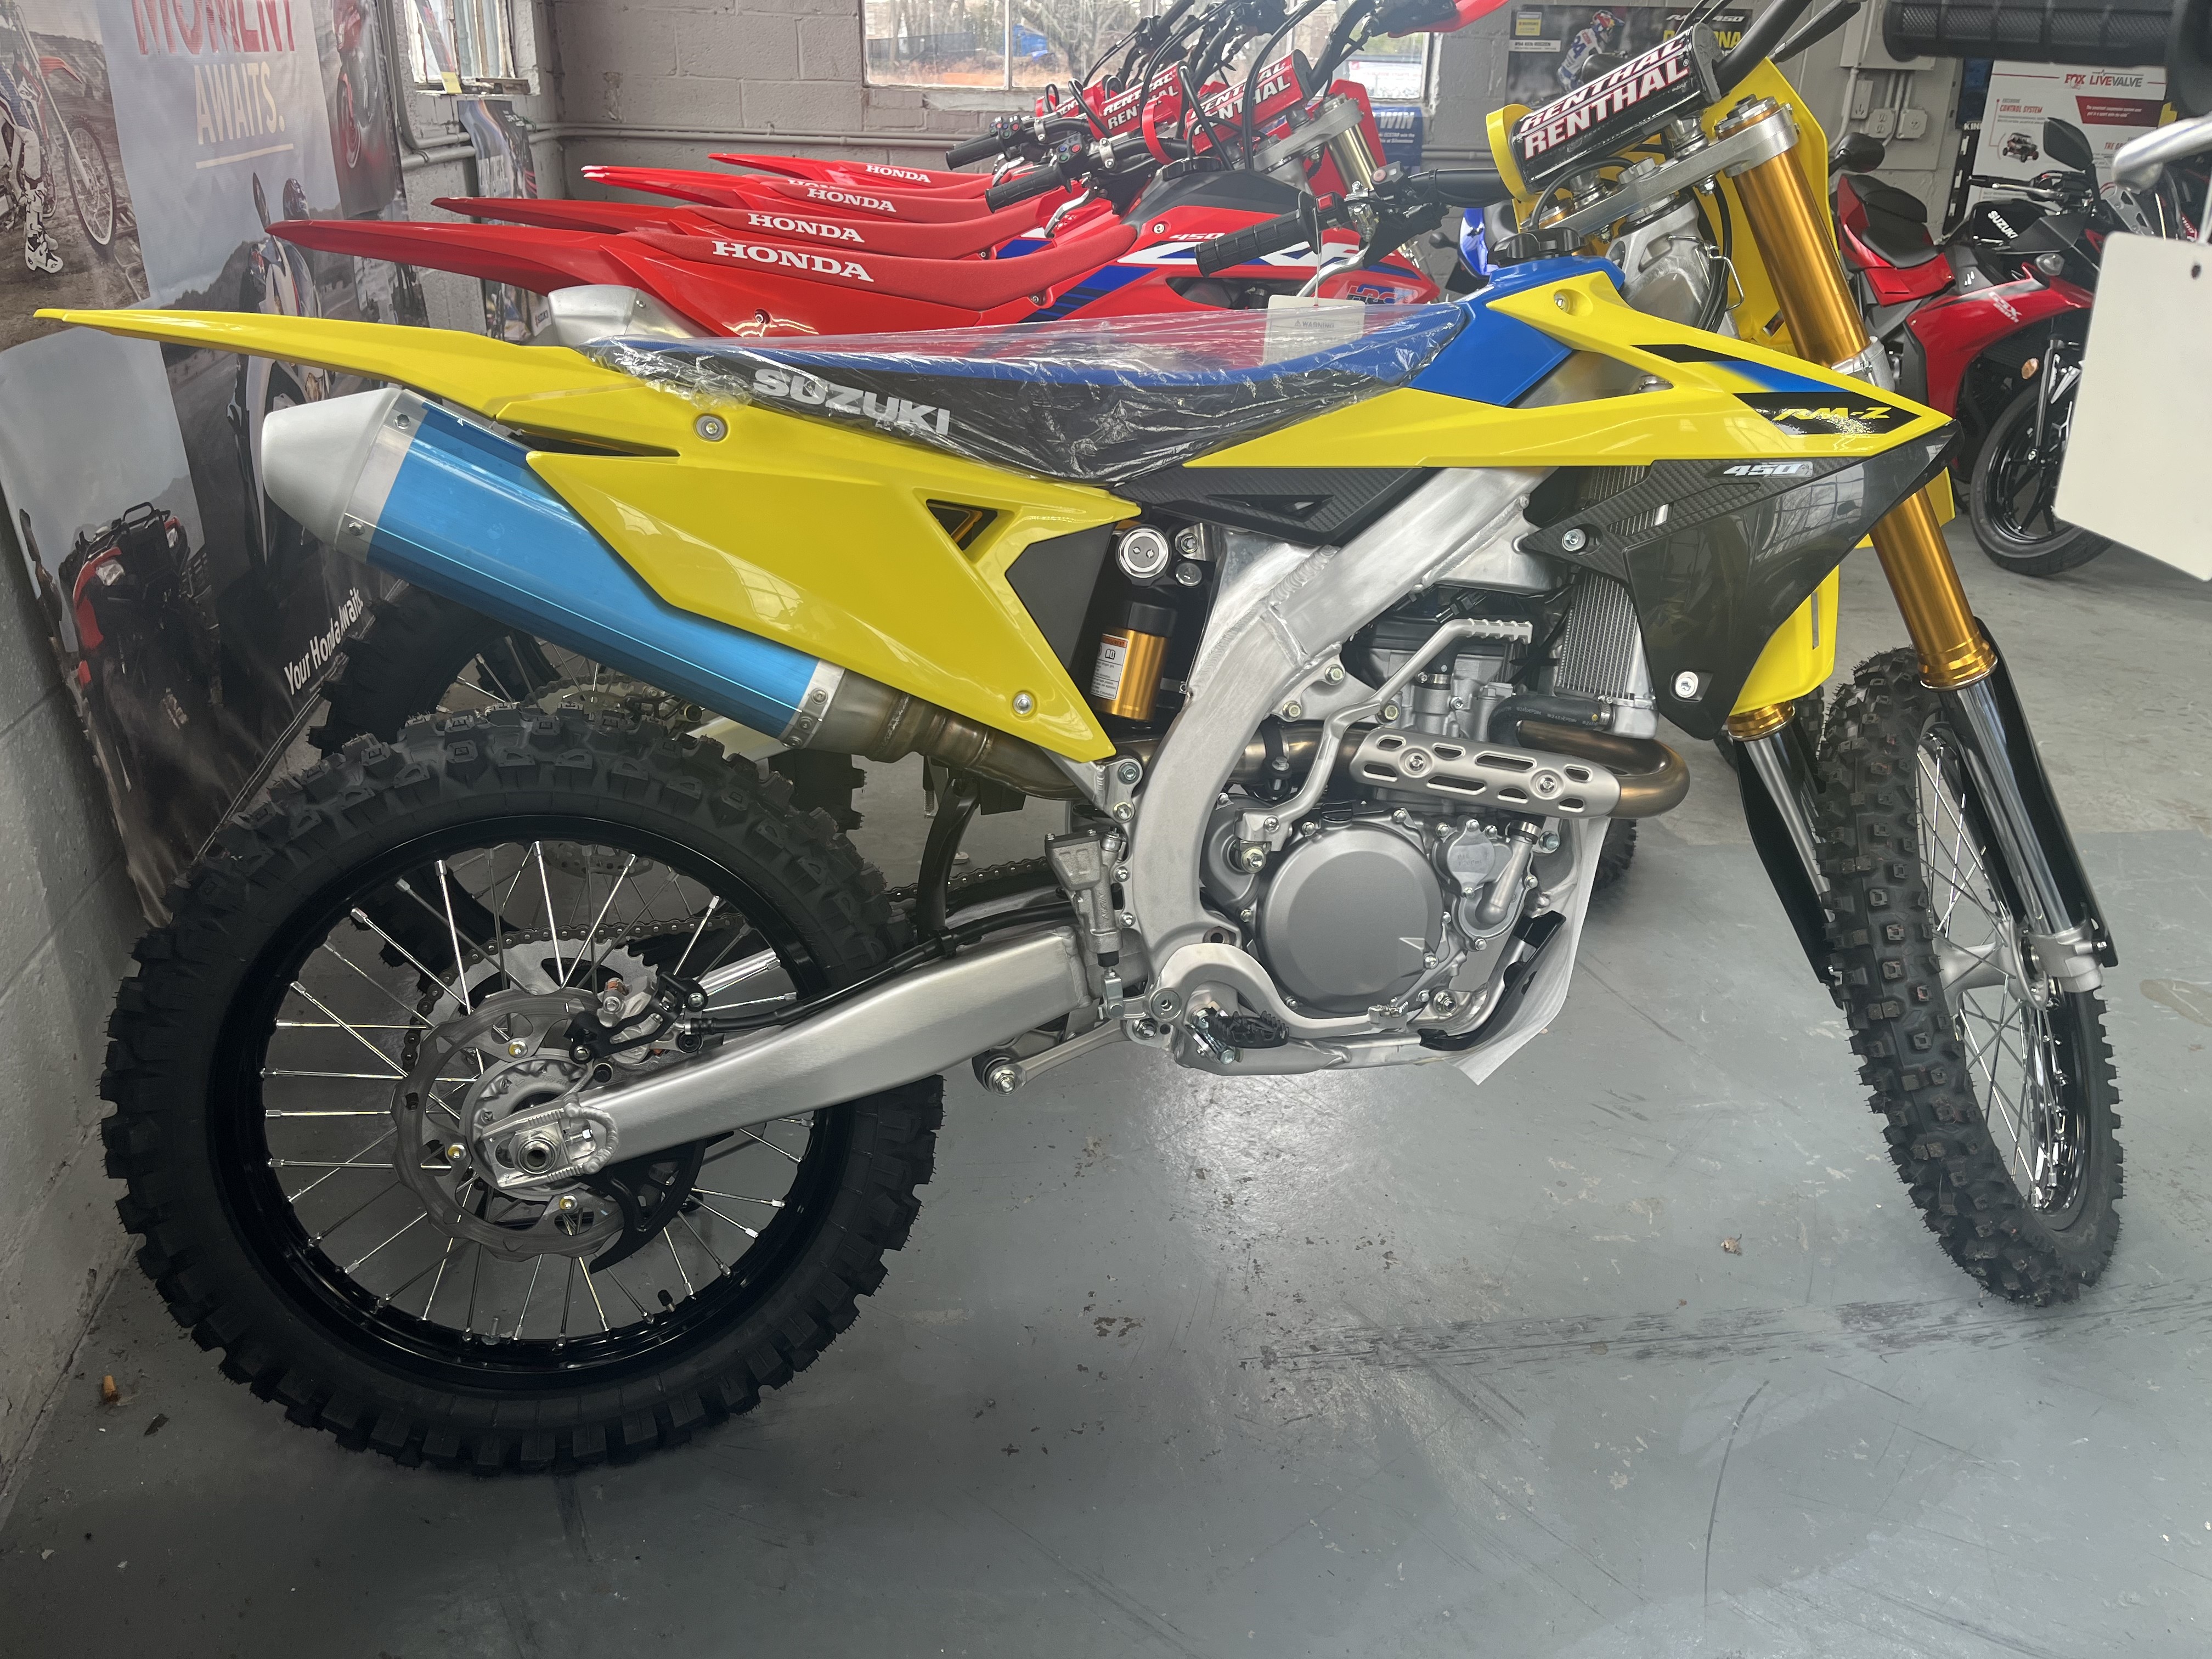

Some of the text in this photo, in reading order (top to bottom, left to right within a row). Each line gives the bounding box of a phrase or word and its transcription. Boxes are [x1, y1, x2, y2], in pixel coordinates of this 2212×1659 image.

[1520, 40, 1683, 133] RENTHAL
[194, 61, 285, 145] AWAITS.
[1525, 56, 1690, 160] RENTHAL
[2000, 105, 2022, 113] CONTROL
[1380, 111, 1415, 129] WIN
[865, 164, 932, 183] HONDA
[807, 187, 897, 212] HONDA
[748, 212, 865, 243] HONDA
[1988, 210, 2019, 239] SUZUKI
[712, 240, 874, 283] HONDA
[753, 368, 950, 436] SUZUKI
[1772, 407, 1893, 421] RM-Z
[1723, 463, 1804, 477] 450
[284, 652, 311, 696] Your
[309, 617, 341, 670] Honda
